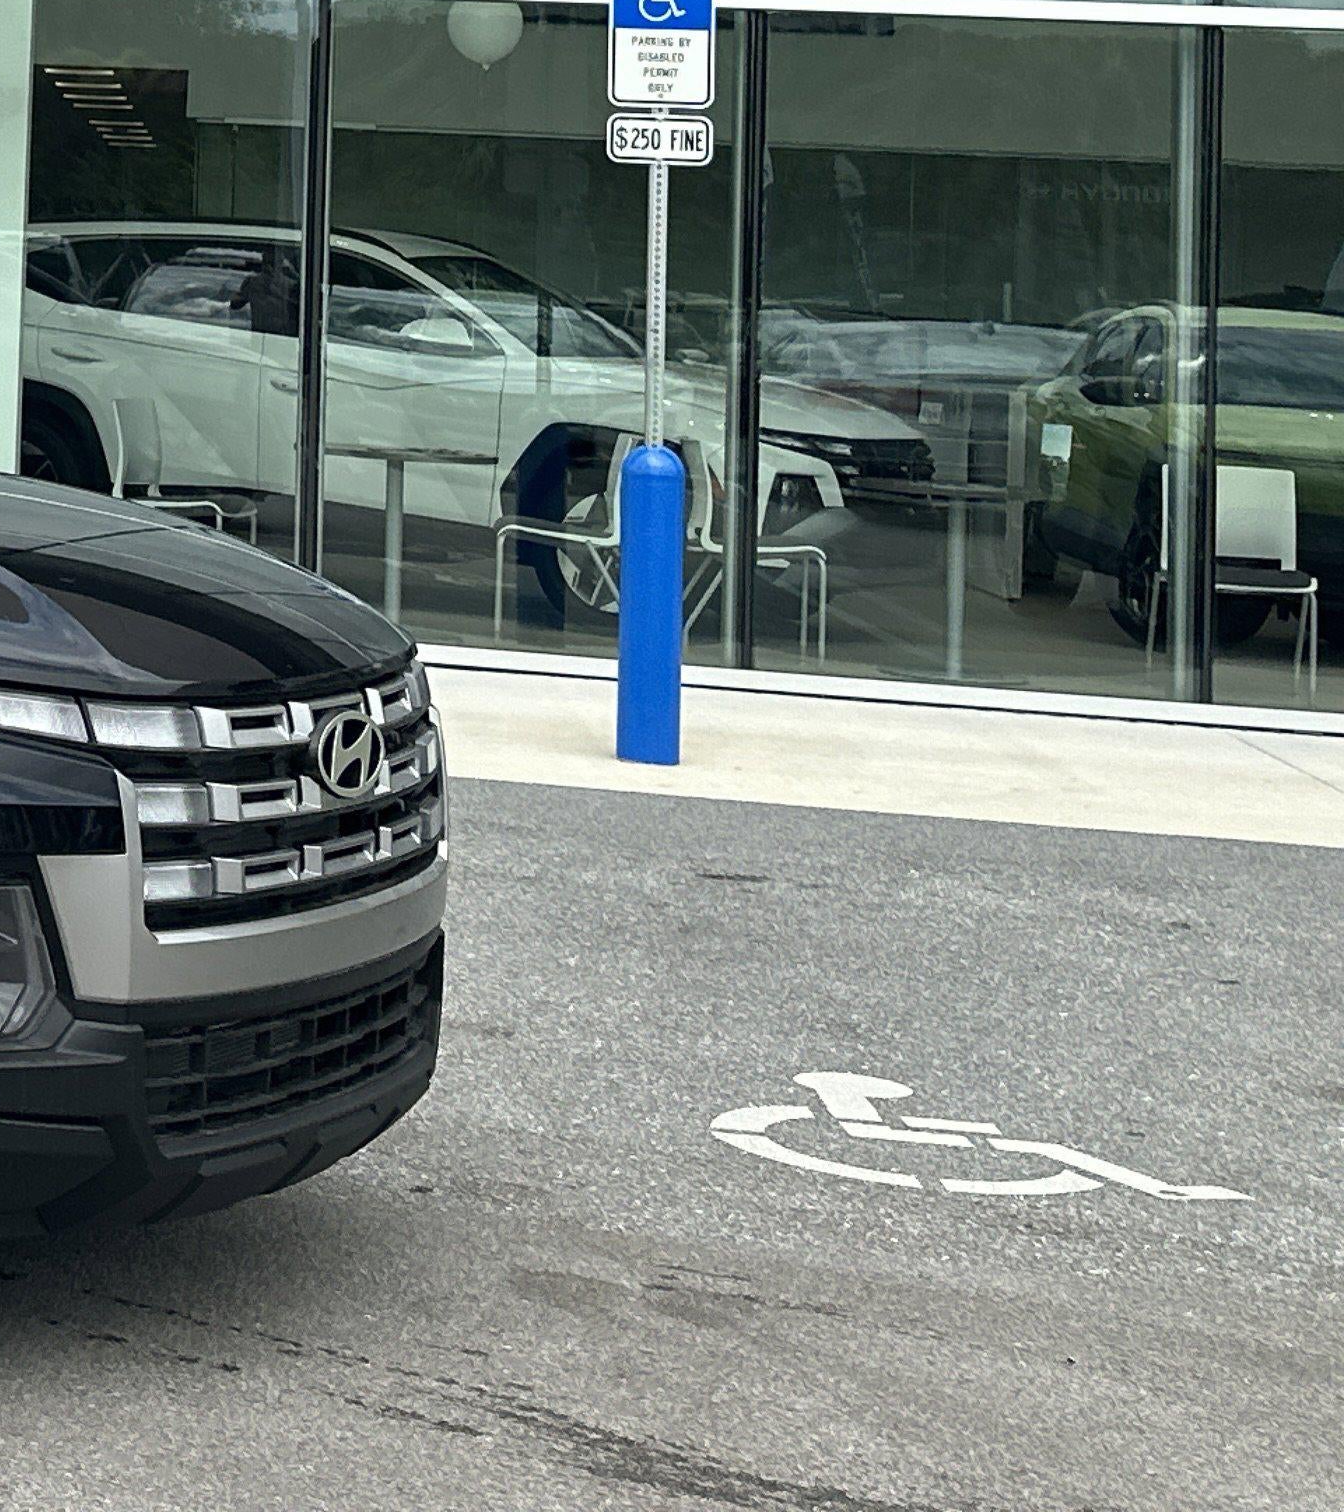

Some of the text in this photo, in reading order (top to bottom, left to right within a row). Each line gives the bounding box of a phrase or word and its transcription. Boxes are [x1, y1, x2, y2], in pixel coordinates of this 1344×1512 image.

[631, 35, 692, 47] PARKING BY
[637, 52, 685, 62] DISABLED
[642, 67, 679, 78] PERMIT
[648, 83, 673, 92] ONLY
[615, 125, 704, 152] $250 FINE
